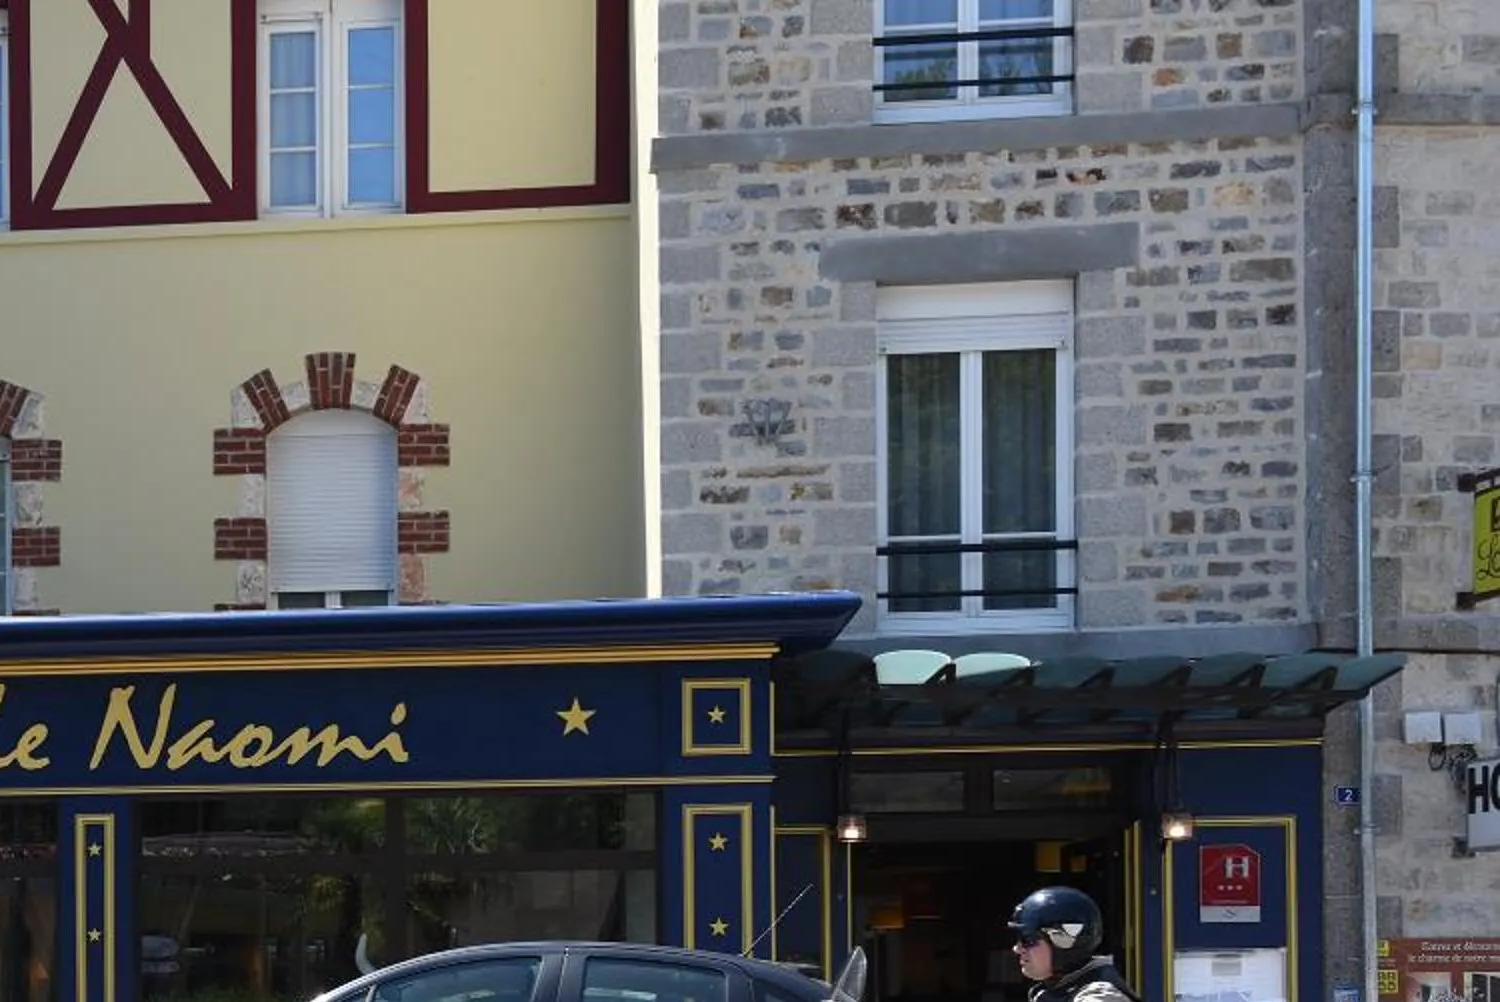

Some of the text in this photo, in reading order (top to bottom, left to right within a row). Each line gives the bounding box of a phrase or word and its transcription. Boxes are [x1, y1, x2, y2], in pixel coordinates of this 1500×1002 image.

[89, 682, 409, 771] Naomi
[1345, 789, 1353, 801] 2
[1225, 856, 1249, 878] H
